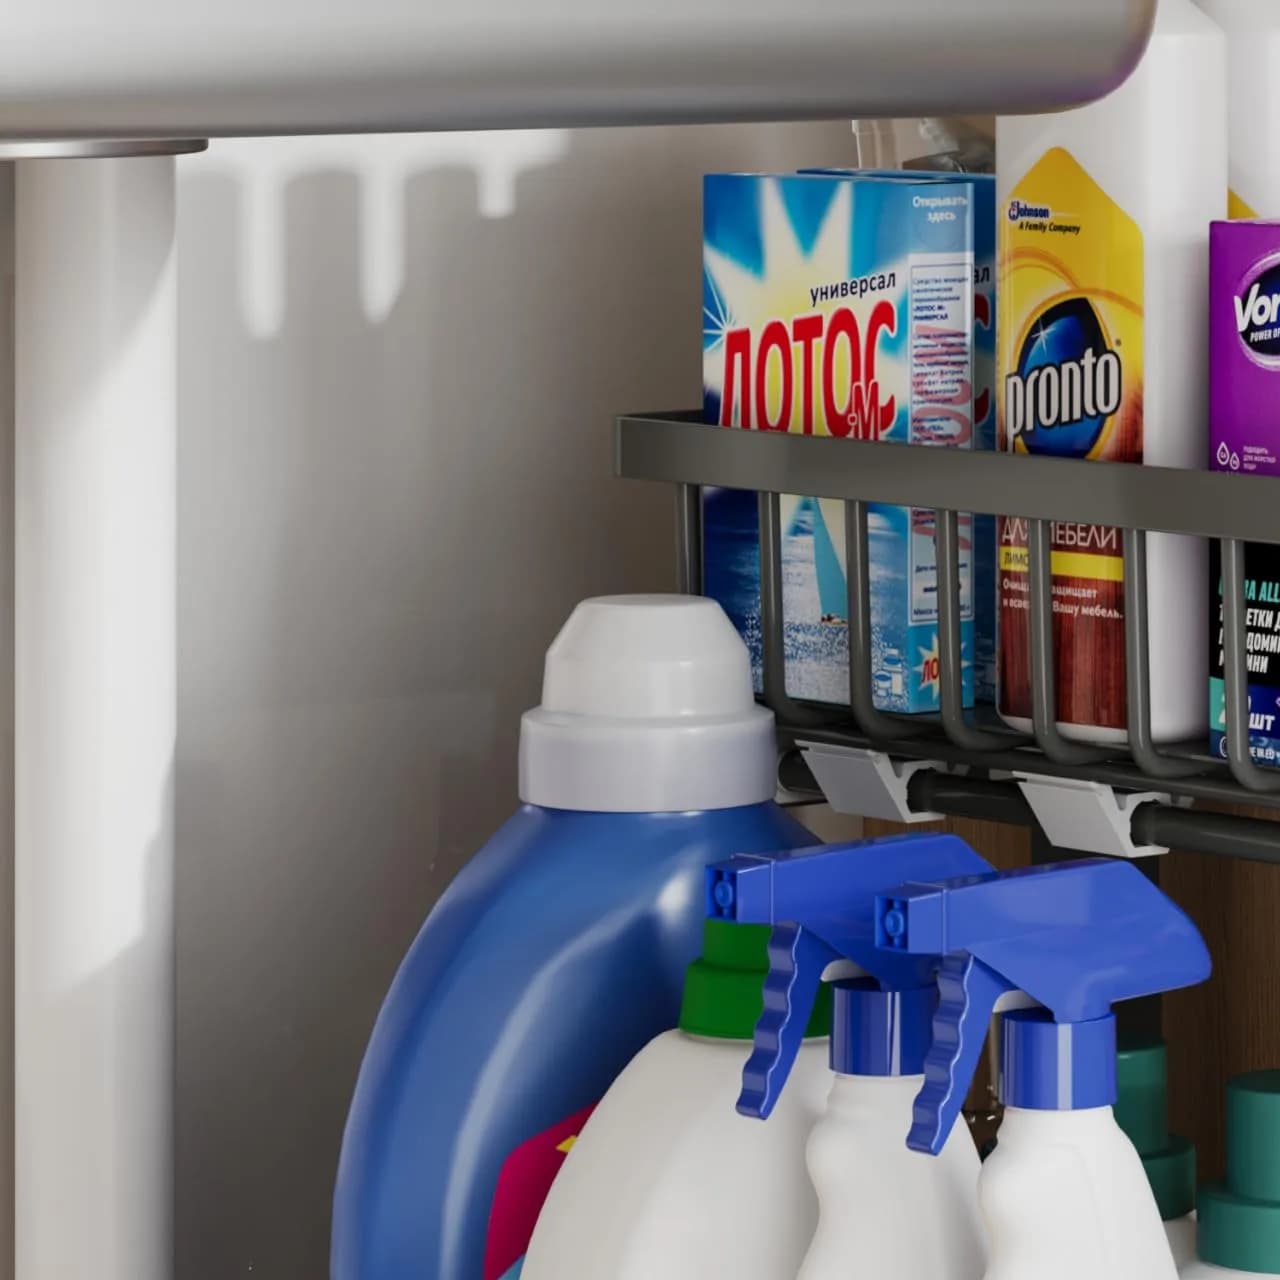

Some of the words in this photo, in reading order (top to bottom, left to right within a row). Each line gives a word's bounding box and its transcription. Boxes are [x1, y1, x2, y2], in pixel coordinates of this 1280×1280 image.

[1019, 221, 1025, 231] A
[810, 271, 896, 306] универсал
[1250, 328, 1272, 343] POWER
[1273, 327, 1280, 339] OF
[720, 300, 896, 438] ЛОТОС
[1006, 347, 1121, 455] pronto
[1050, 520, 1118, 550] ЕБЕЛИ
[1258, 580, 1280, 603] ALL
